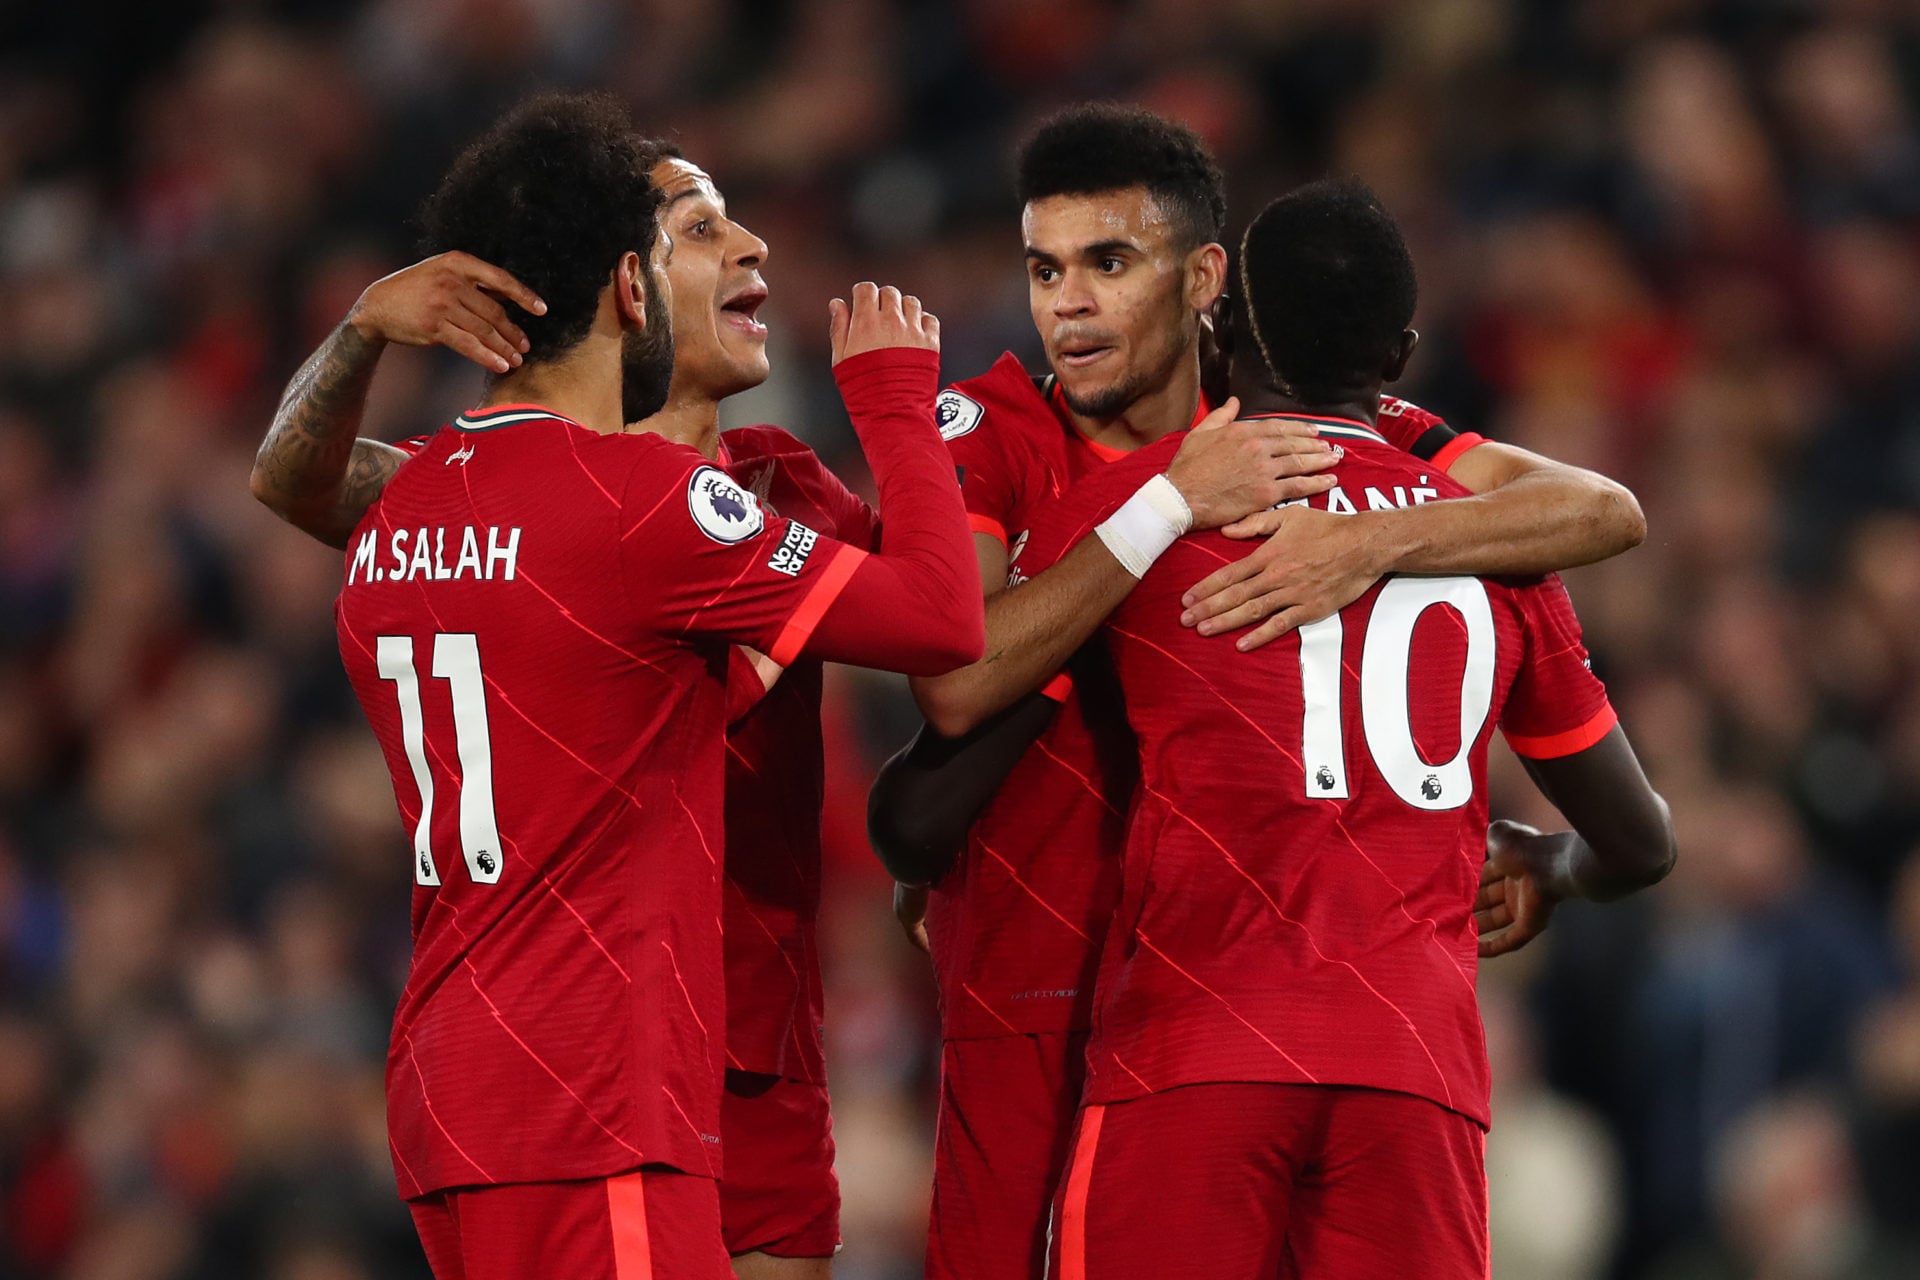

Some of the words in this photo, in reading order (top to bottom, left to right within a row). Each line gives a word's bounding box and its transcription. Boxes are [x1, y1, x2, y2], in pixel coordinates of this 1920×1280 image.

[1268, 474, 1439, 516] ANÉ
[347, 525, 522, 586] M.SALAH
[768, 547, 792, 572] No
[1298, 576, 1496, 811] 10
[376, 633, 504, 886] 11
